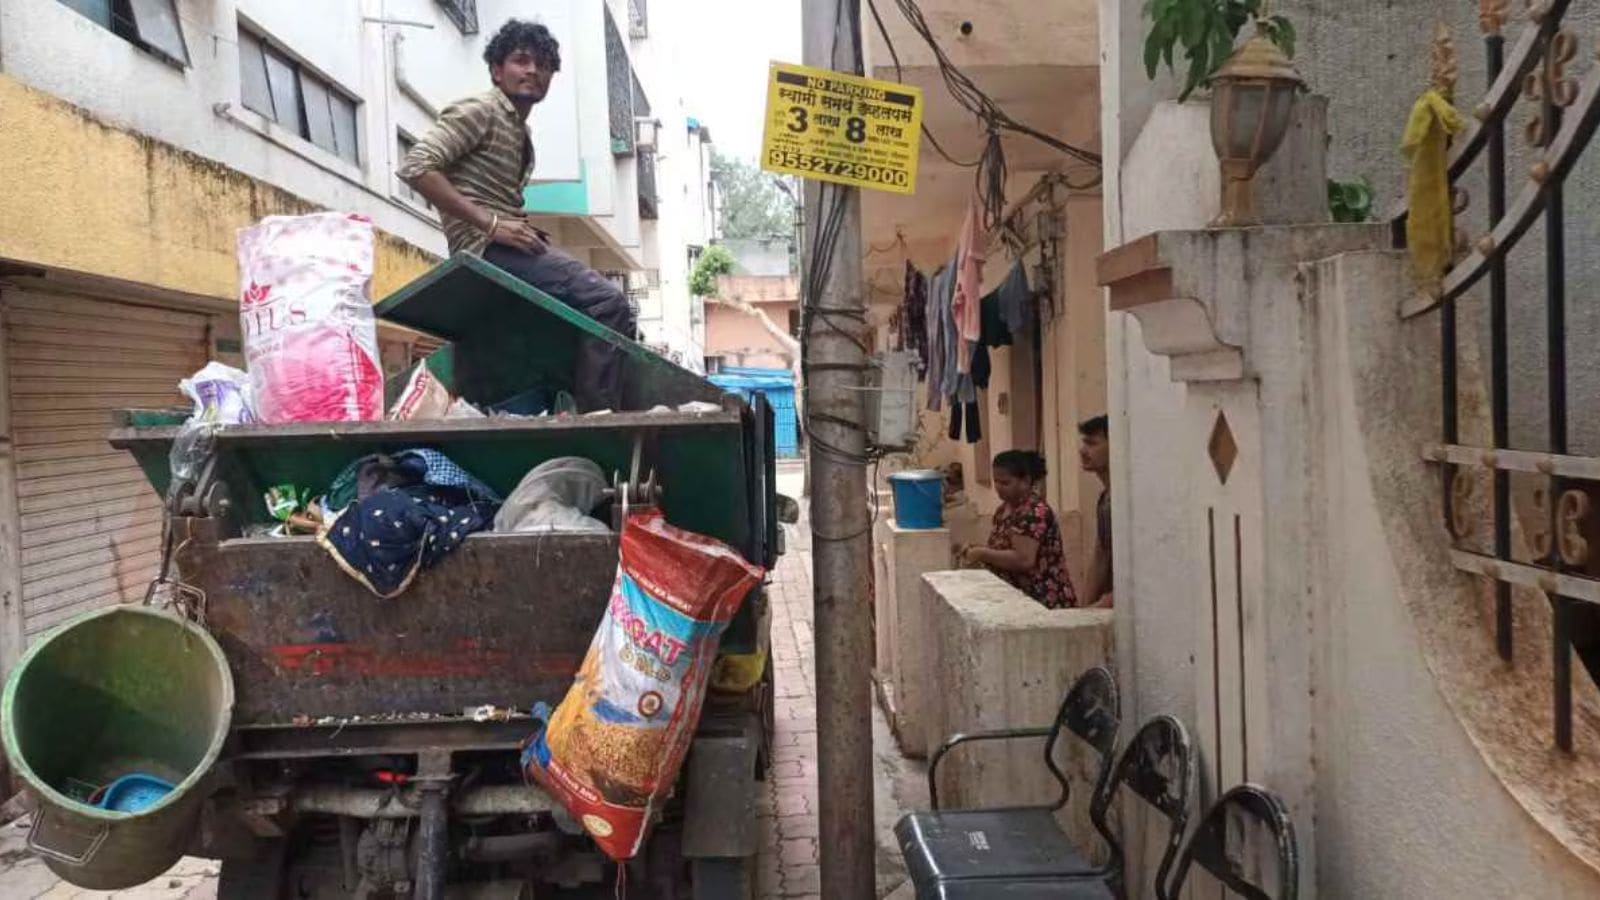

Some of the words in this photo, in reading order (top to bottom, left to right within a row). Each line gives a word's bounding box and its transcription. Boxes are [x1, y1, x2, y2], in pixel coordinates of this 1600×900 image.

[807, 77, 826, 91] NO
[829, 80, 886, 100] PARKING
[786, 106, 808, 133] 3
[812, 113, 841, 128] लाख
[845, 116, 867, 144] 8
[875, 124, 903, 139] लाख
[769, 149, 908, 187] 9552729000
